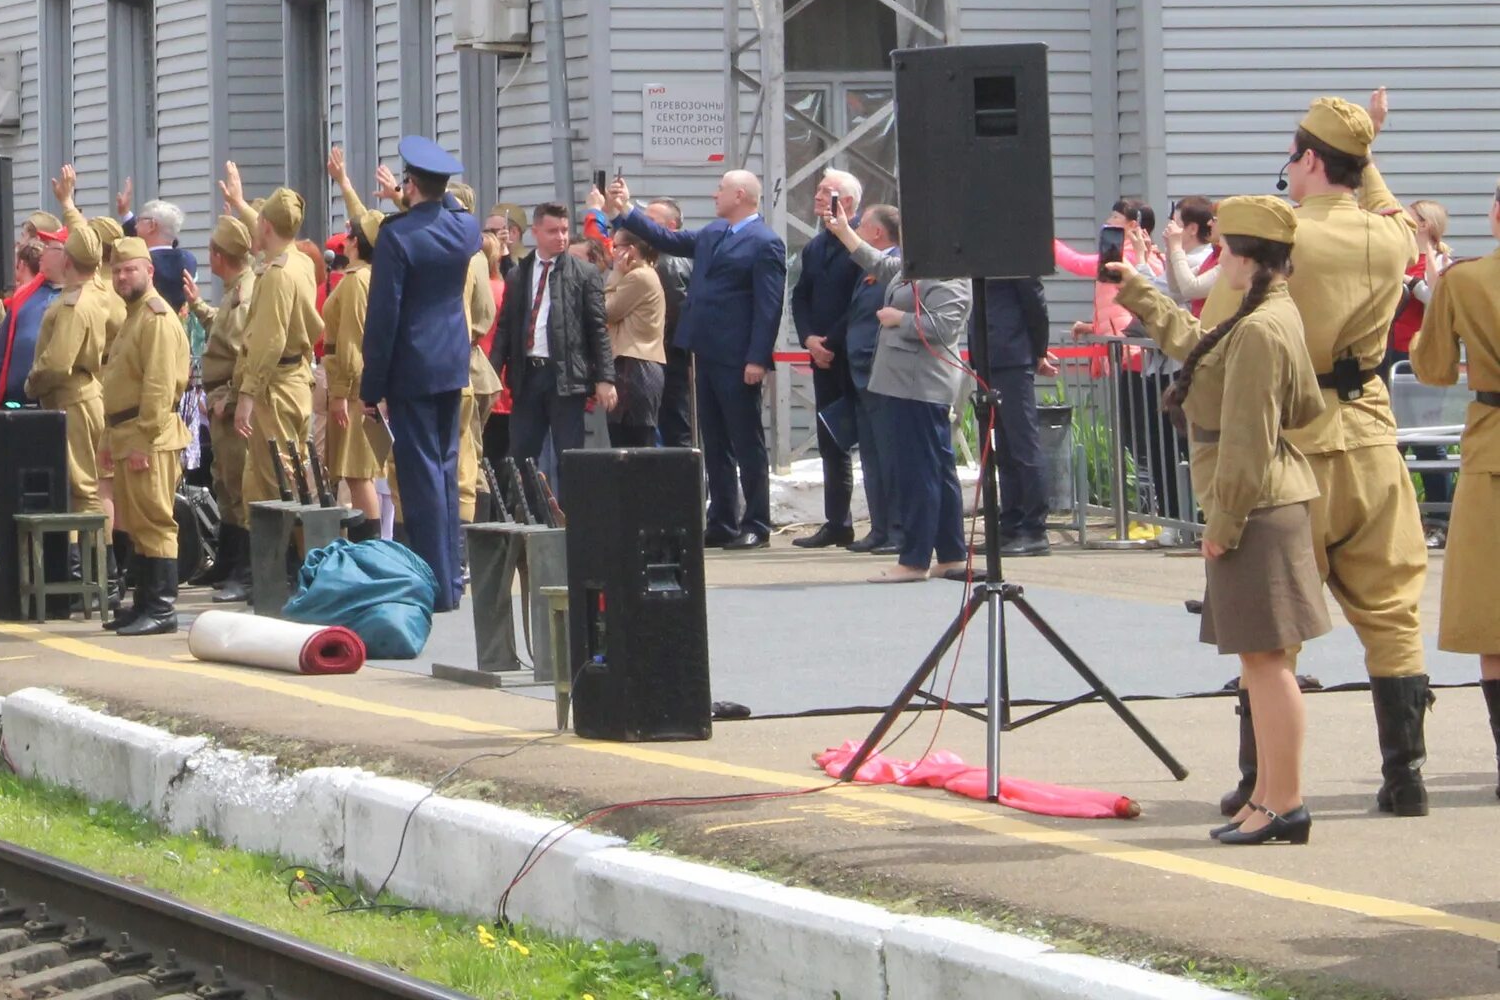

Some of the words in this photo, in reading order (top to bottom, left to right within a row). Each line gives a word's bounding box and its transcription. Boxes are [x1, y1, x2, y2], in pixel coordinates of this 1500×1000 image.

[650, 101, 724, 110] ПЕРЕВОЗОЧНЫ
[656, 113, 694, 122] СЕКТОР
[697, 113, 726, 122] ЗОНЫ
[651, 125, 724, 134] ТРАНСПОРТНО
[651, 137, 724, 146] БЕЗОПАСНОСТ
